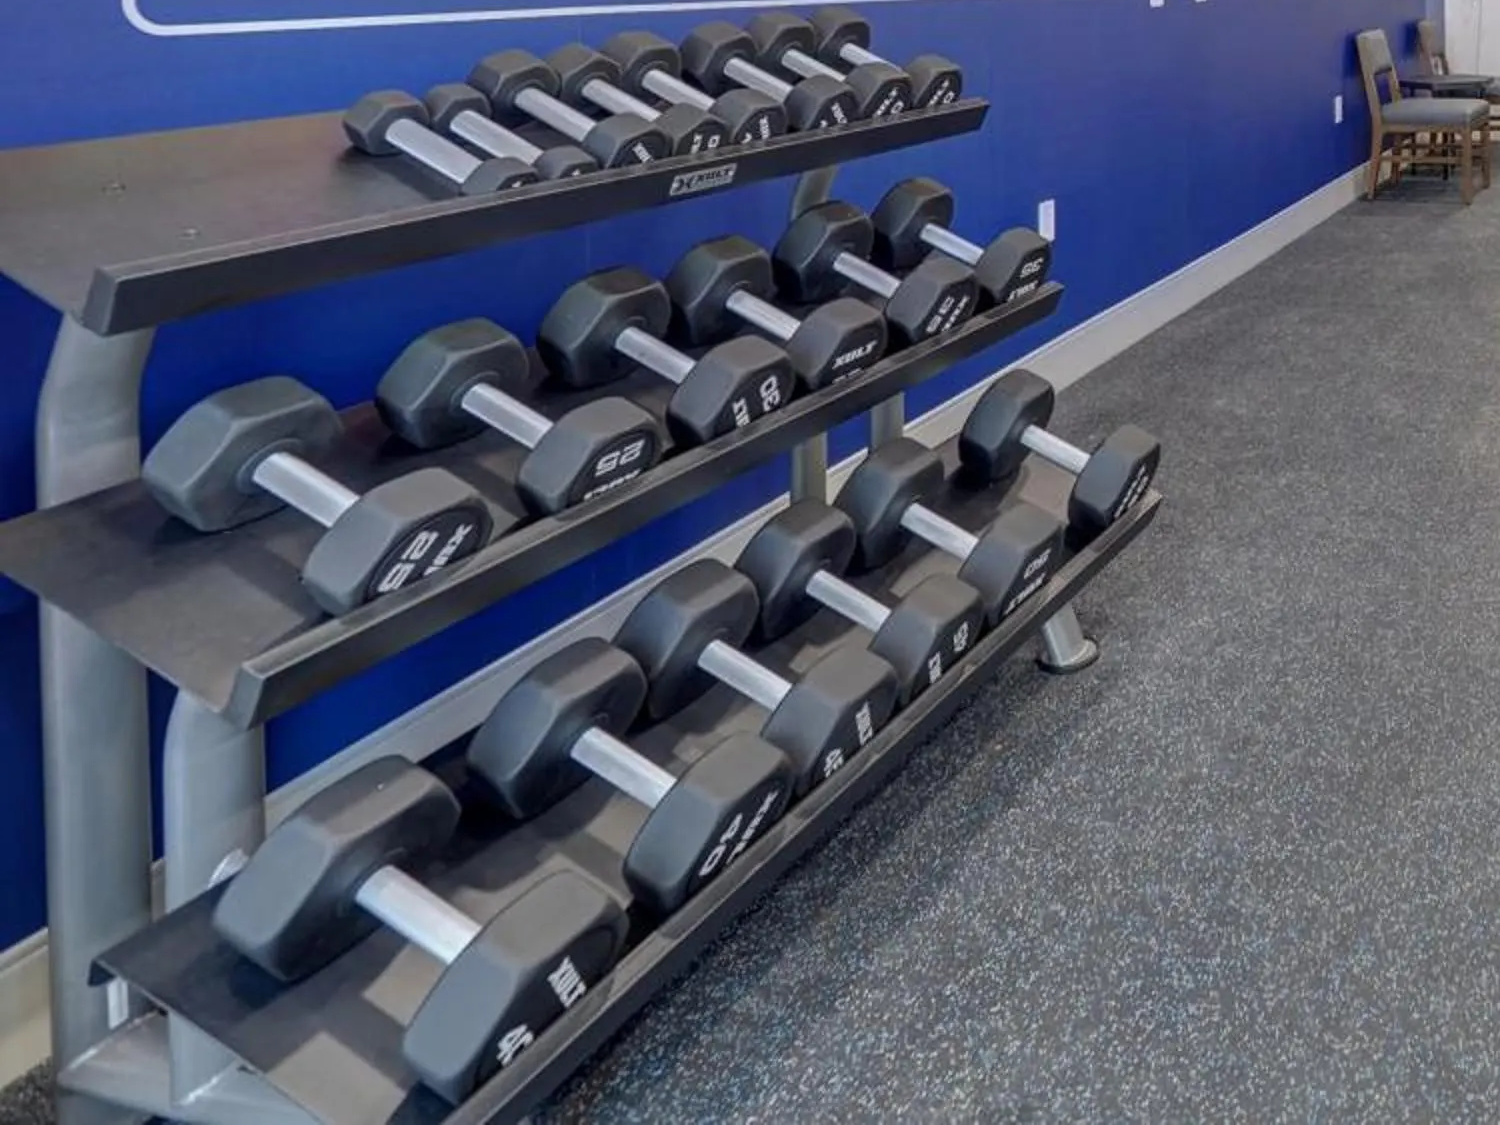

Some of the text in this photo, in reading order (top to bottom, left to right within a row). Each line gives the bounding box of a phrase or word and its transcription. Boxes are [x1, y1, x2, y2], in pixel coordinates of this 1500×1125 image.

[831, 339, 878, 371] XULT
[759, 374, 781, 413] 30
[594, 438, 646, 478] 25
[378, 530, 440, 593] 25
[546, 954, 588, 1009] XULT
